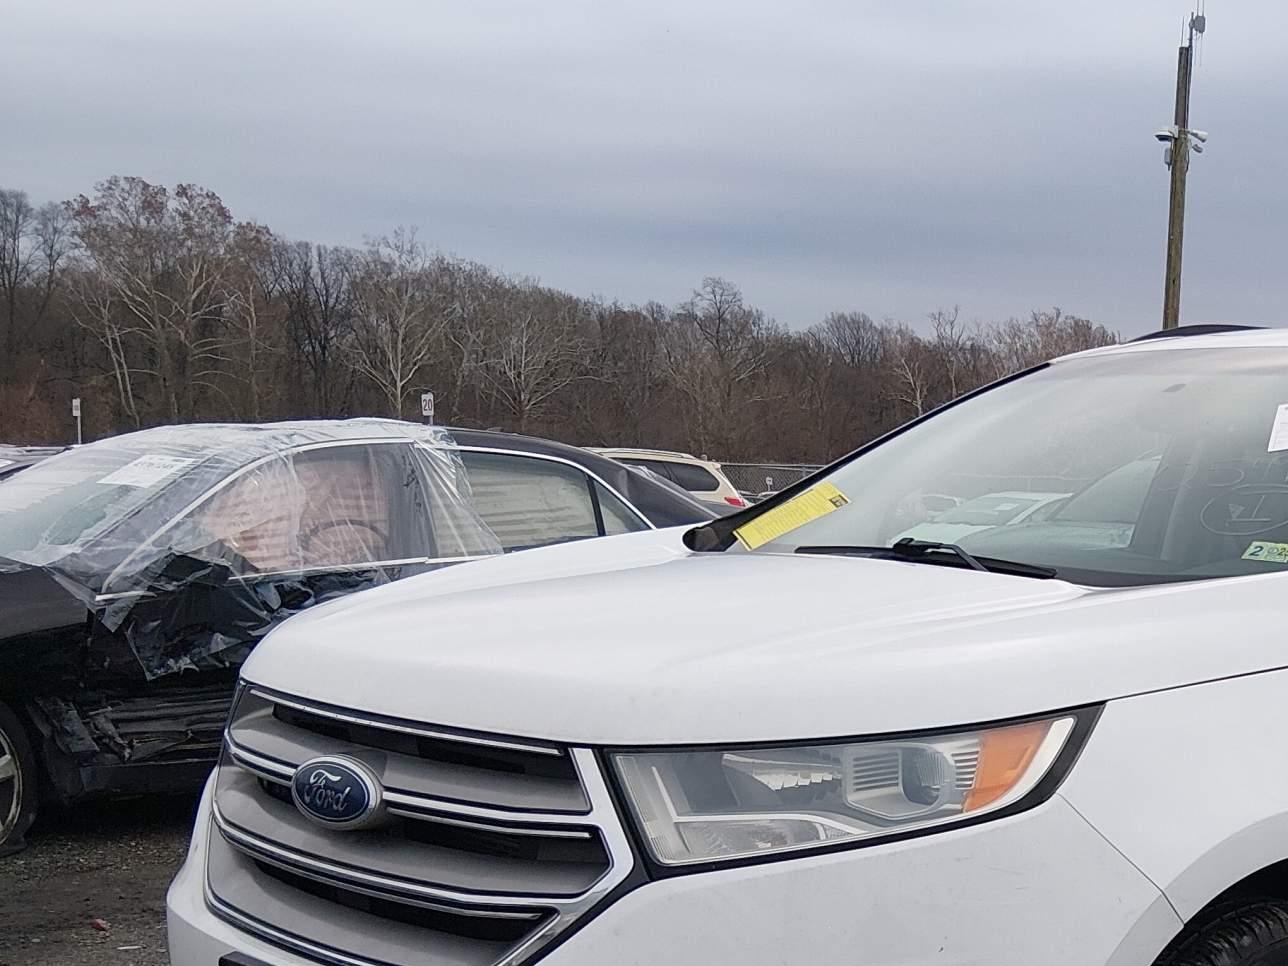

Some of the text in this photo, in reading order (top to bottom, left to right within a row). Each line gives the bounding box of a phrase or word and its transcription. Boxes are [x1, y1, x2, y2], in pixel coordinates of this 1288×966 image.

[423, 399, 433, 411] 20
[1248, 545, 1264, 556] 2
[304, 769, 352, 812] Ford
